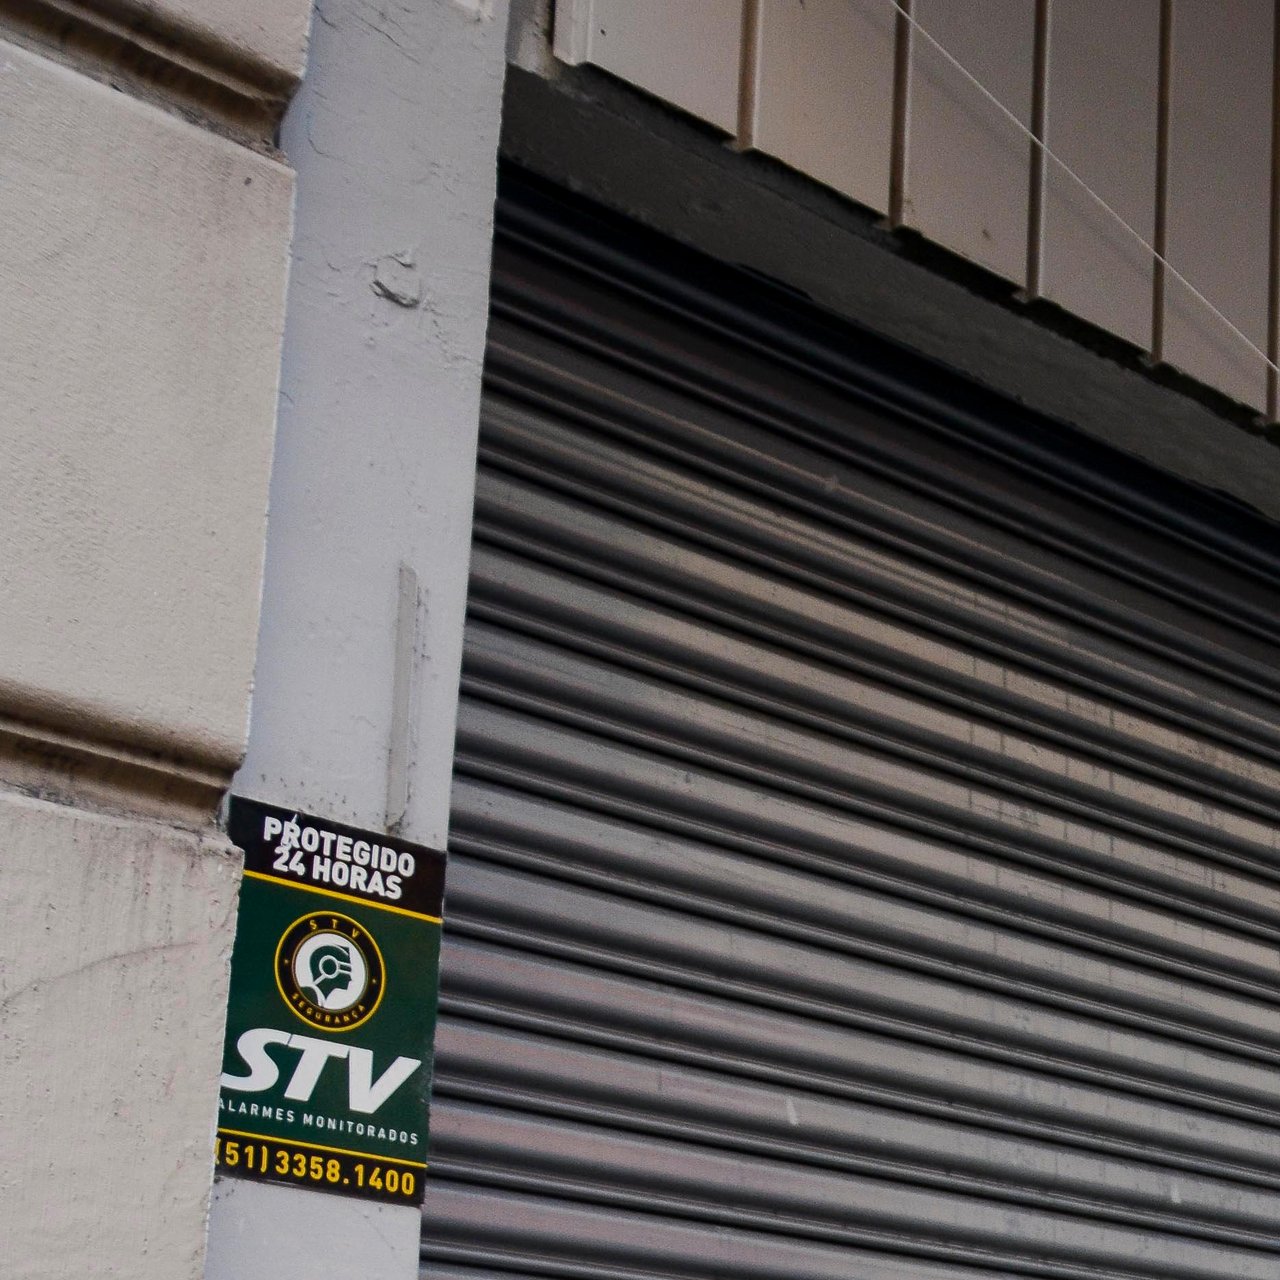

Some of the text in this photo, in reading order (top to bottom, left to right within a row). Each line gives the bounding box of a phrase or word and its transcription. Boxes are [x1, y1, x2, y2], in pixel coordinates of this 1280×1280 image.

[263, 816, 415, 878] PROTEGIDO
[273, 846, 403, 900] 24 HORAS
[309, 919, 360, 938] STV
[220, 1028, 421, 1114] STV
[218, 1097, 295, 1123] ALARMES
[303, 1113, 419, 1145] MONITORADOS
